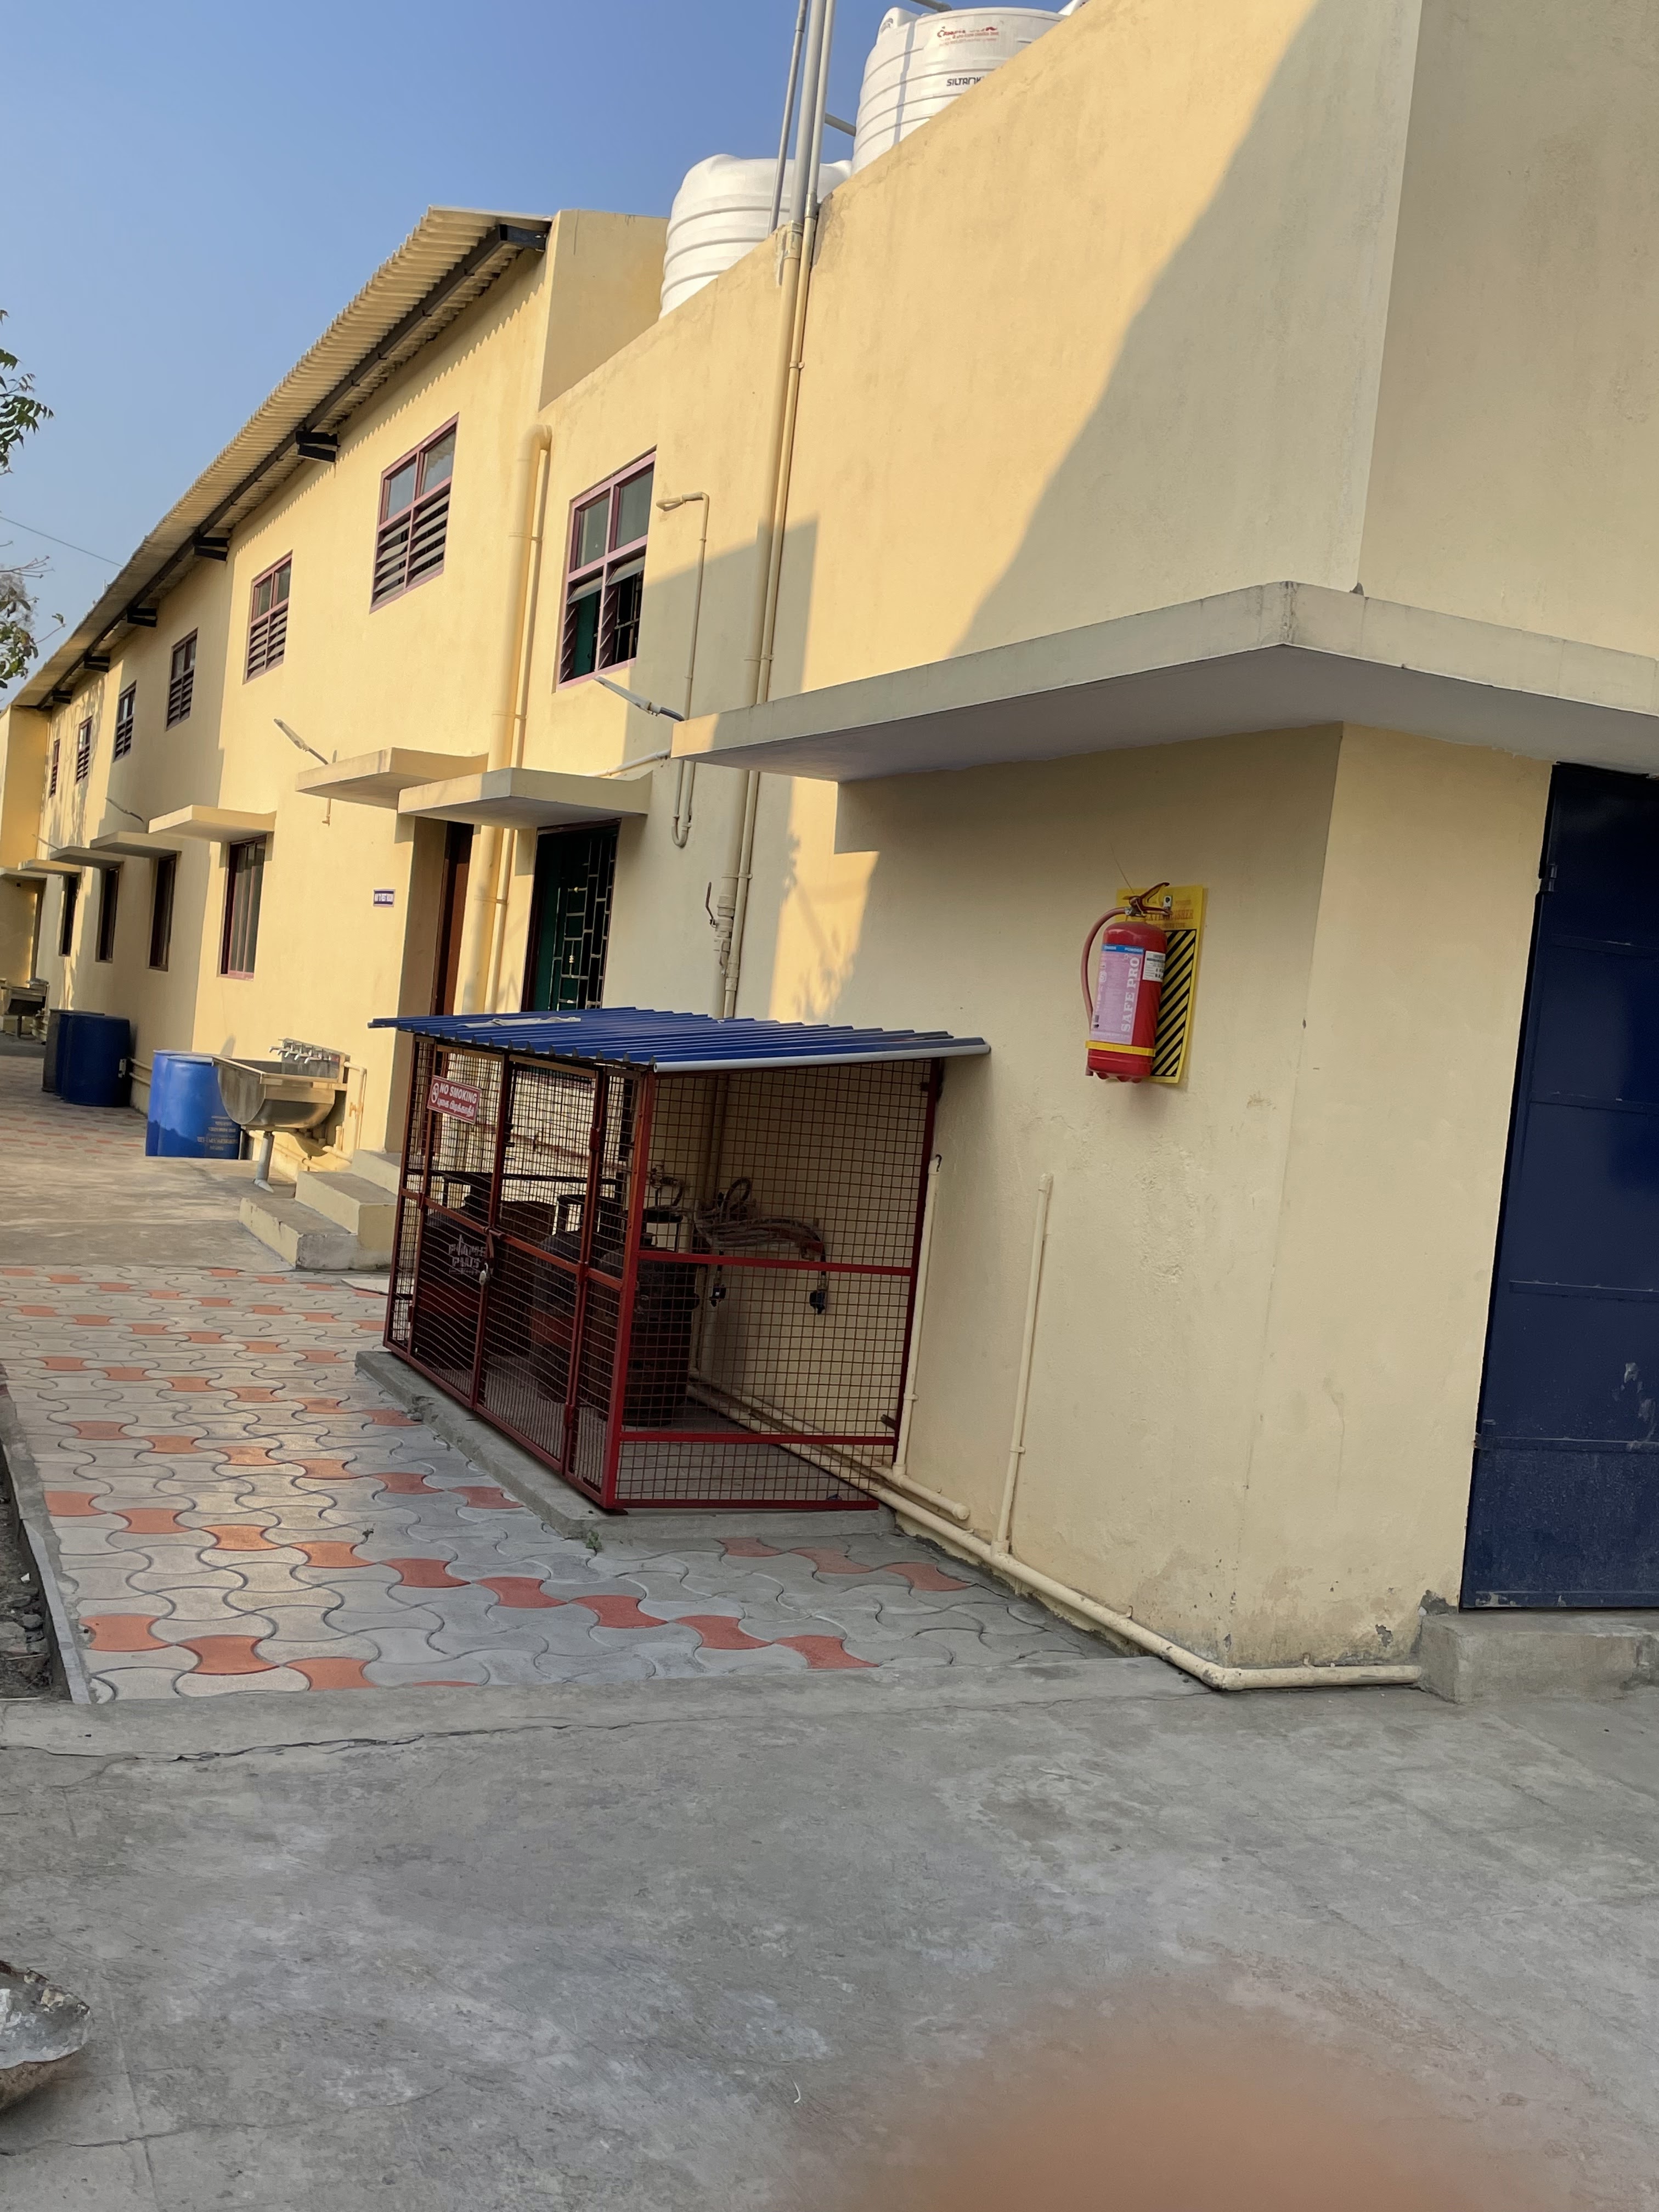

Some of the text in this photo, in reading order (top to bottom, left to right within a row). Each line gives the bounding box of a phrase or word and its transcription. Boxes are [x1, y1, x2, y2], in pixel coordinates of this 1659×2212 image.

[1121, 957, 1140, 1032] SAFE PRO
[439, 1082, 477, 1104] NO SMOKING
